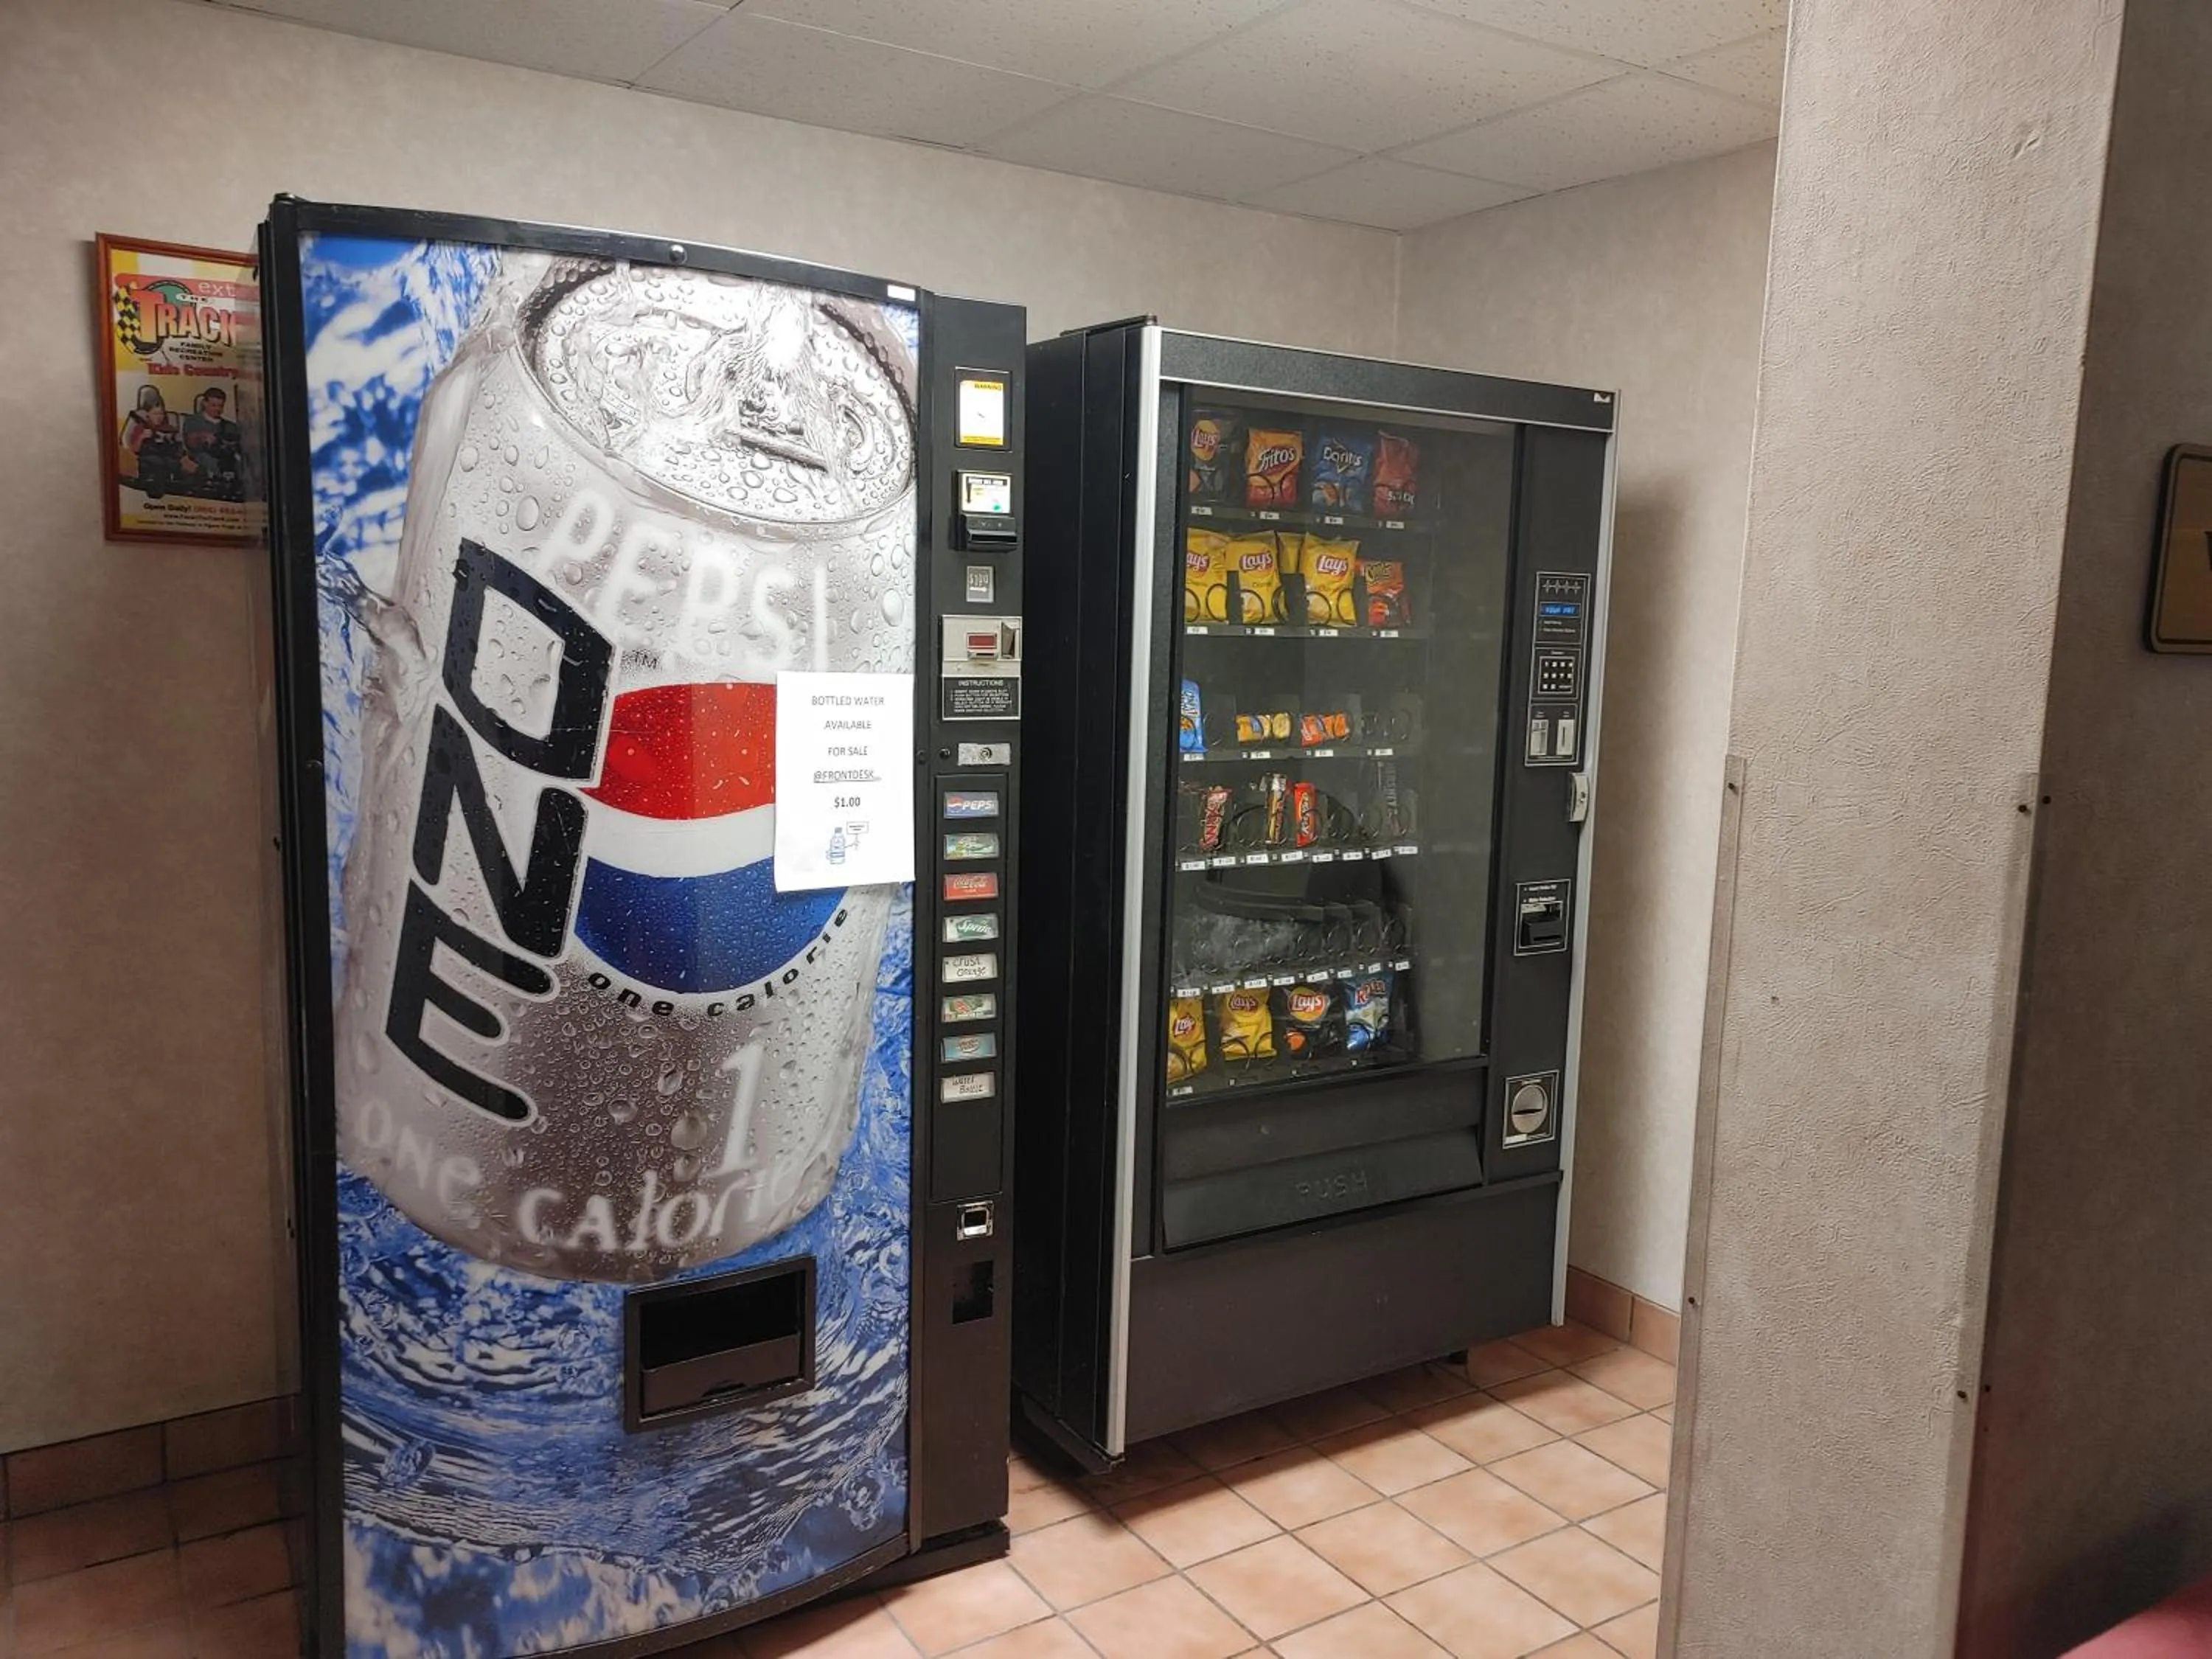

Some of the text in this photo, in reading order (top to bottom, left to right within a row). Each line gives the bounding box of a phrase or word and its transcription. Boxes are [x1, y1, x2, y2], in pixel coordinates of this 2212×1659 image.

[131, 288, 237, 347] TRACK
[1258, 446, 1296, 470] Fritos
[542, 490, 828, 672] PEPSI
[812, 695, 885, 706] BOTTLED WATER
[824, 720, 872, 730] AVAILABLE
[828, 746, 868, 757] FOR SALE
[834, 796, 861, 807] $1.00
[386, 537, 613, 1121] ONE
[589, 909, 848, 1017] one calorie
[1295, 1169, 1368, 1200] PUSH
